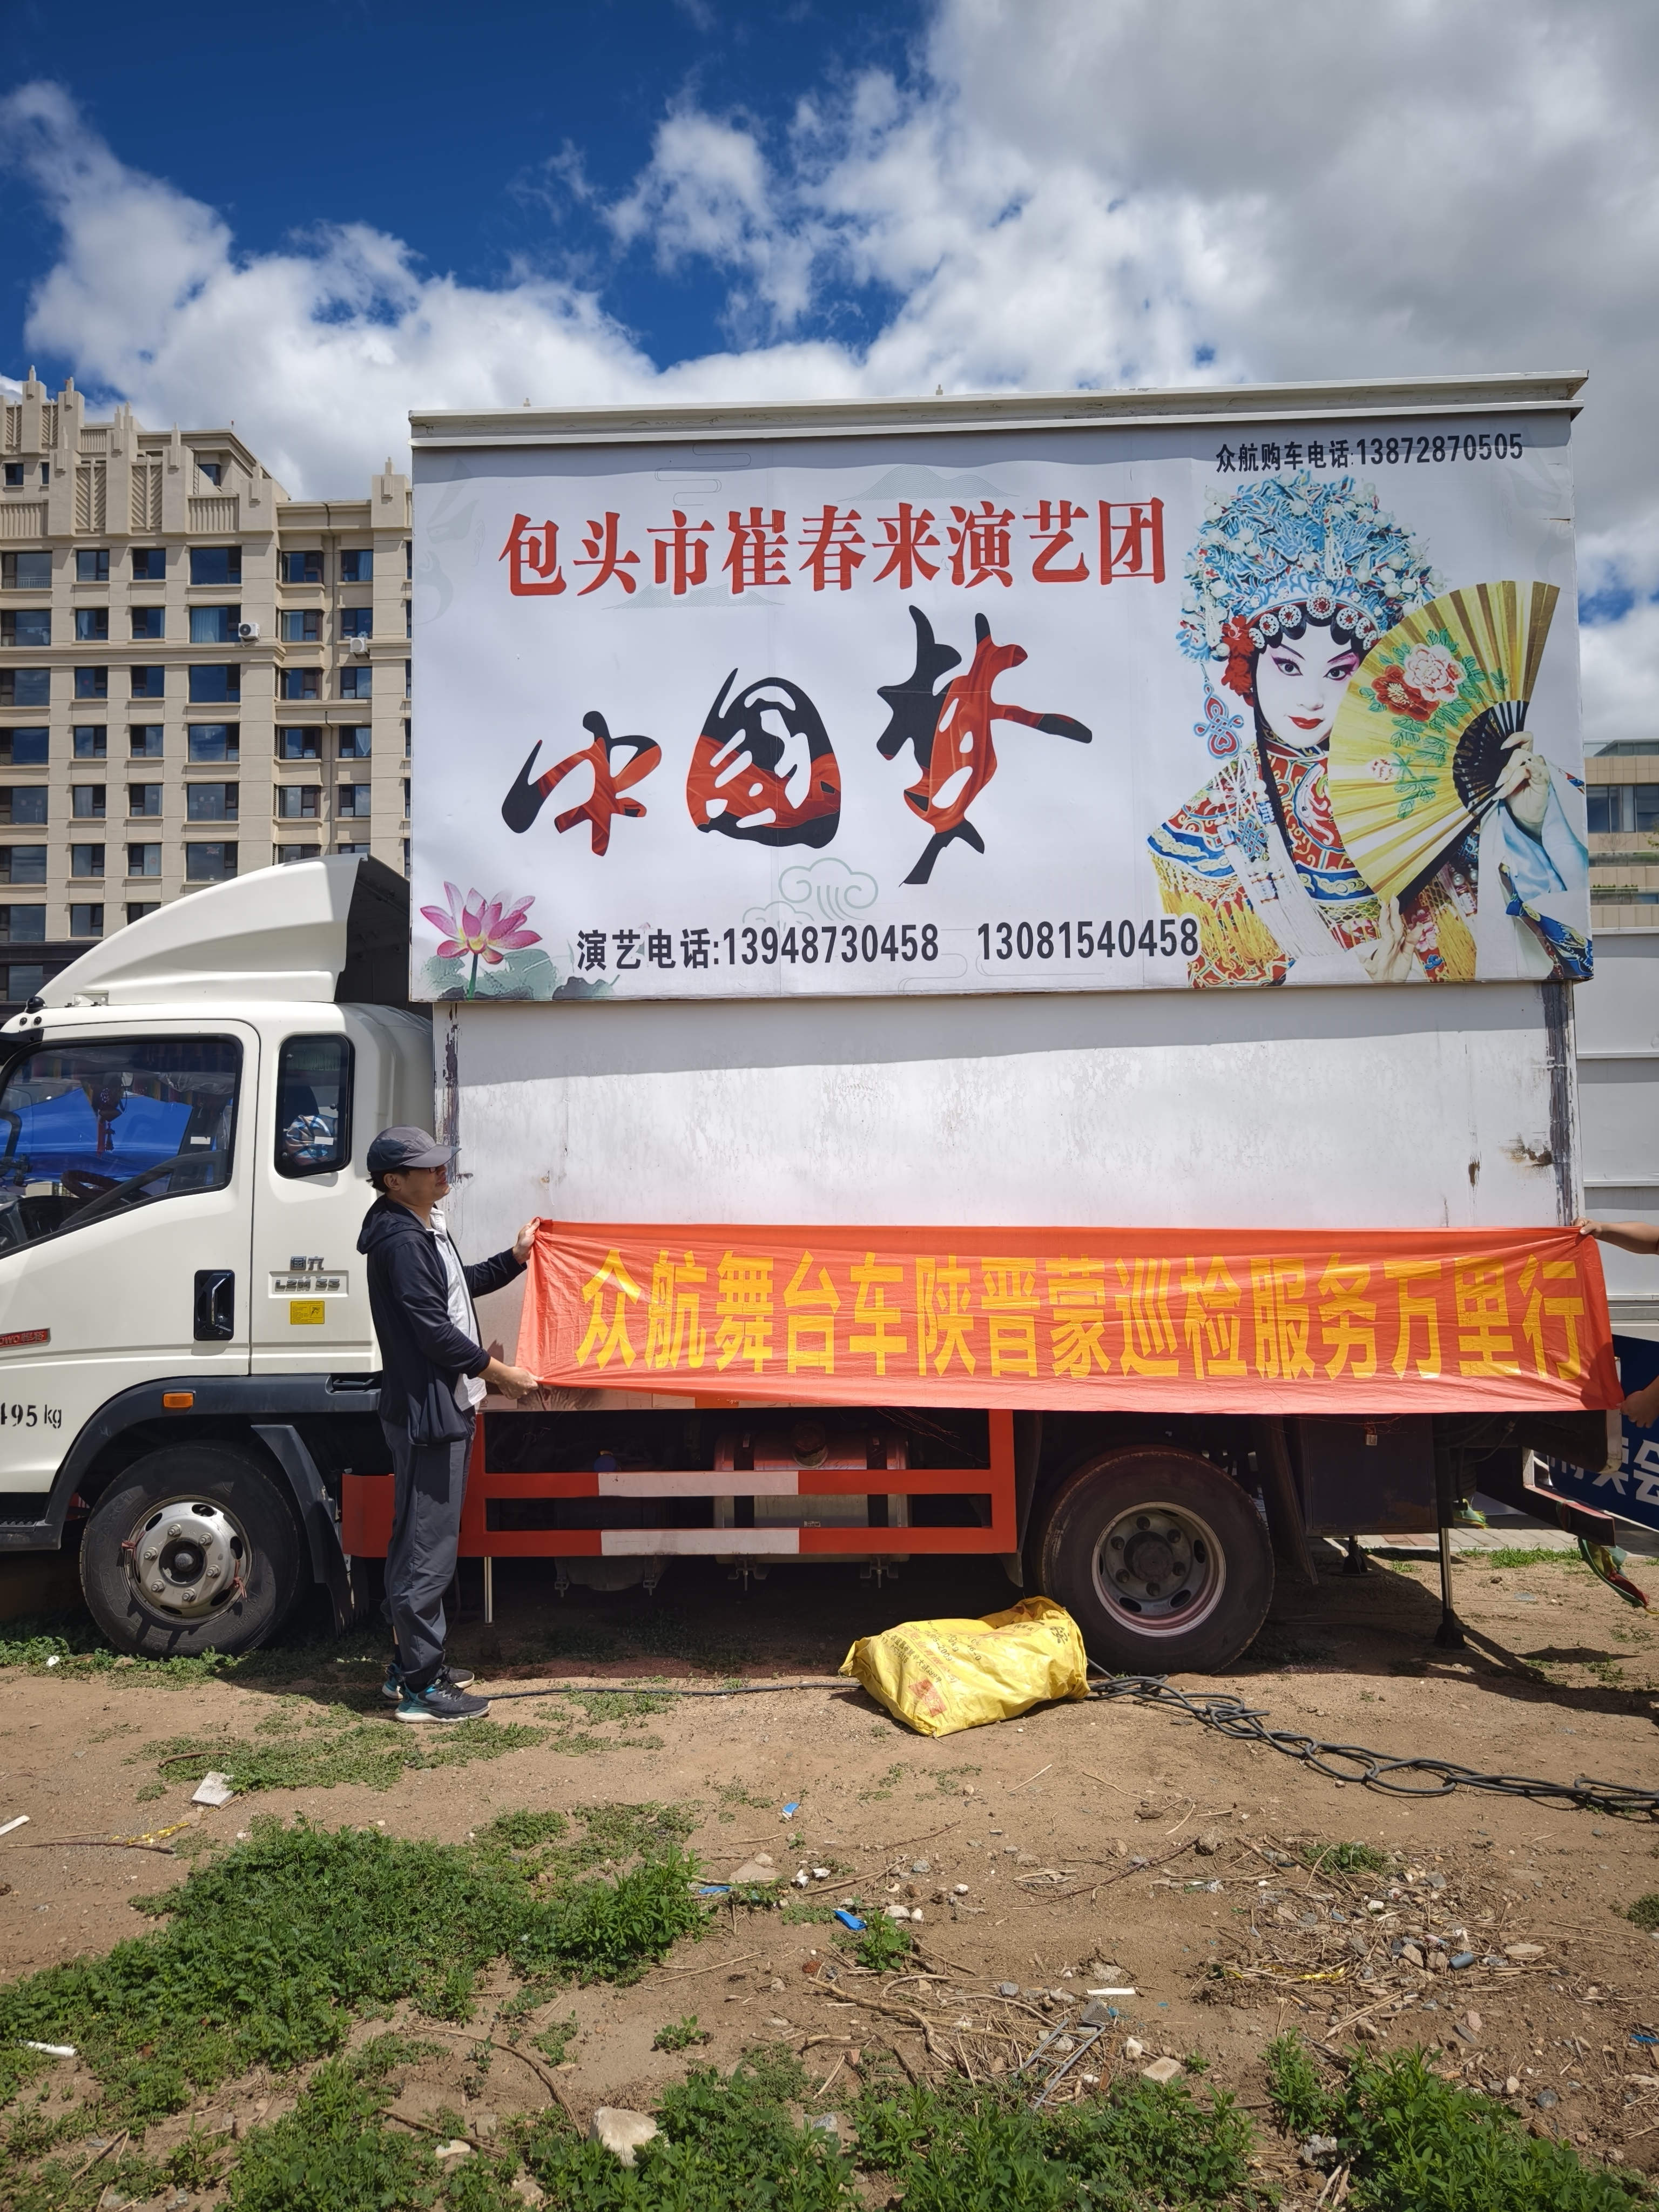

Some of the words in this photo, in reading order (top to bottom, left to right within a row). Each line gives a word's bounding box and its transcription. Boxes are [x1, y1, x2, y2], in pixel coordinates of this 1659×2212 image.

[1216, 433, 1523, 473] 众航购车电话:13872870505
[498, 497, 1165, 597] 包头市崔春来演艺团
[501, 605, 1093, 887] 中国梦
[577, 923, 939, 971] 演艺电话:13948730458
[977, 918, 1198, 960] 13081540458
[290, 1256, 324, 1271] 国六
[575, 1249, 1583, 1380] 众航舞台车陕晋蒙巡检服务万里行
[44, 1404, 62, 1429] kg
